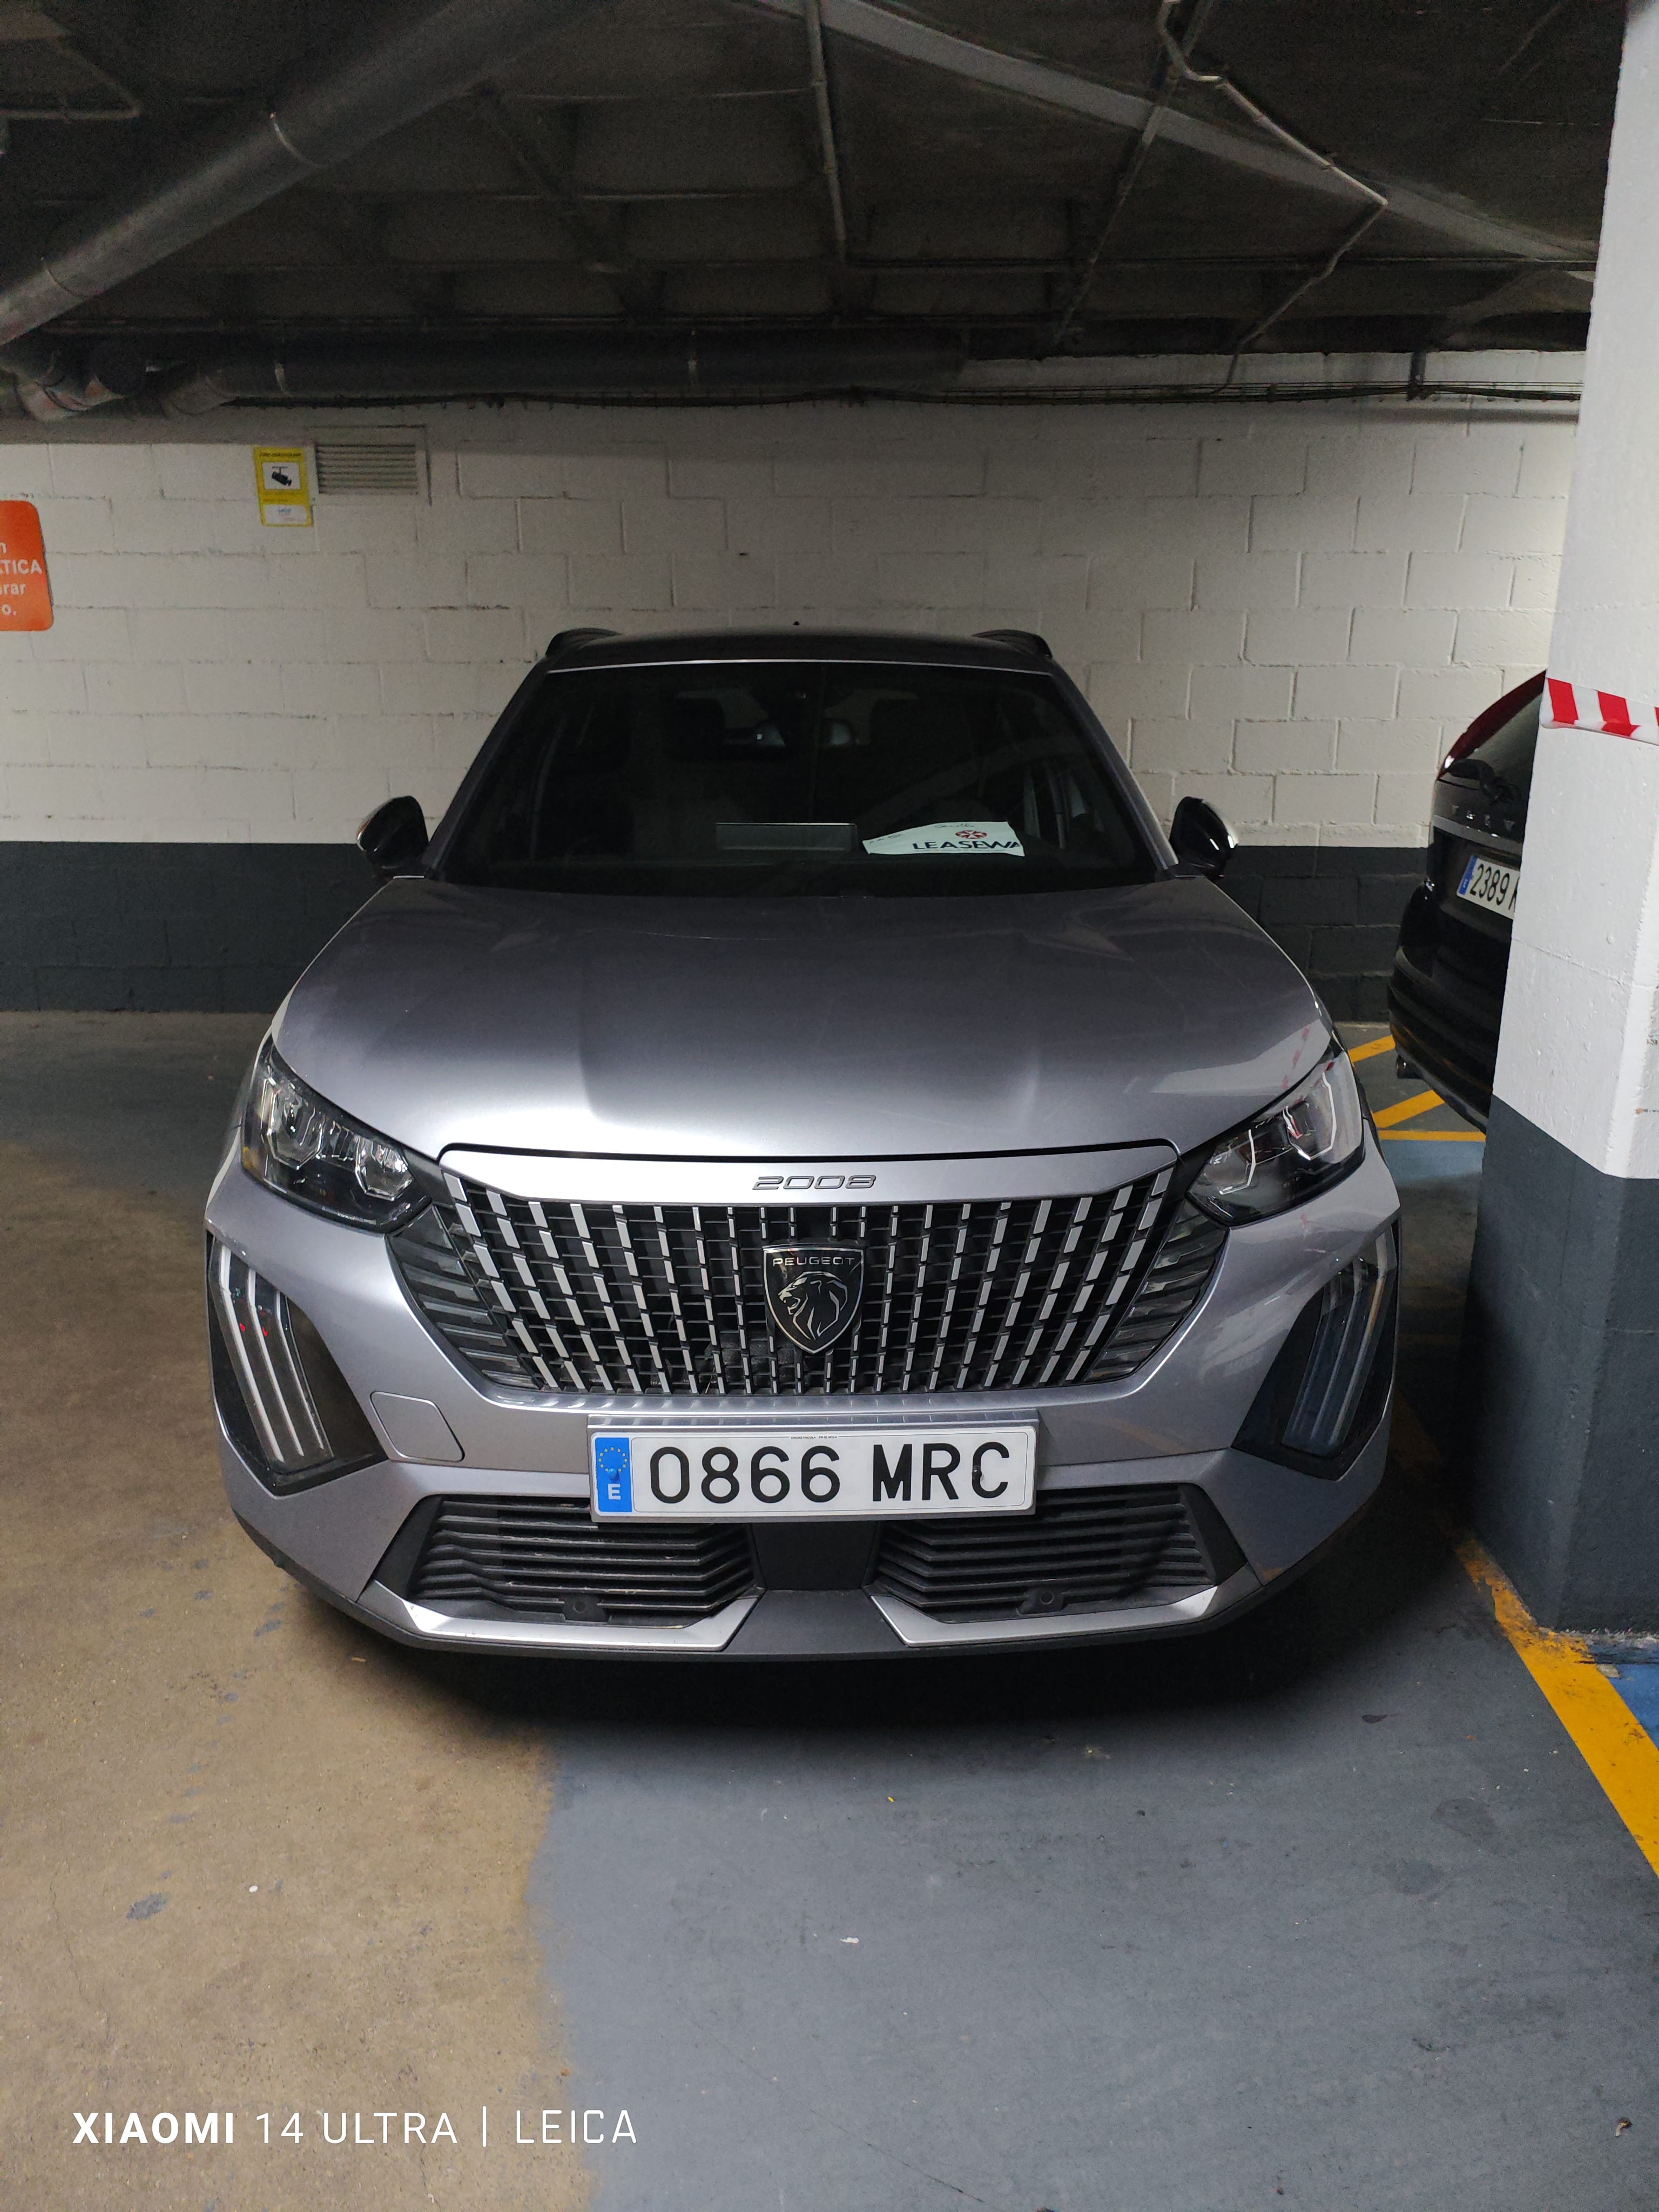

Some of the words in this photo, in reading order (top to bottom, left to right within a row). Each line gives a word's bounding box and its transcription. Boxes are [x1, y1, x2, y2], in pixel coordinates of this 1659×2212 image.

[0, 558, 43, 575] TICA
[1470, 864, 1510, 906] 2389
[752, 1175, 876, 1190] 2008
[773, 1257, 855, 1266] PEUGEOT
[650, 1446, 840, 1504] 0866
[872, 1441, 1009, 1501] MRC
[608, 1483, 621, 1500] E
